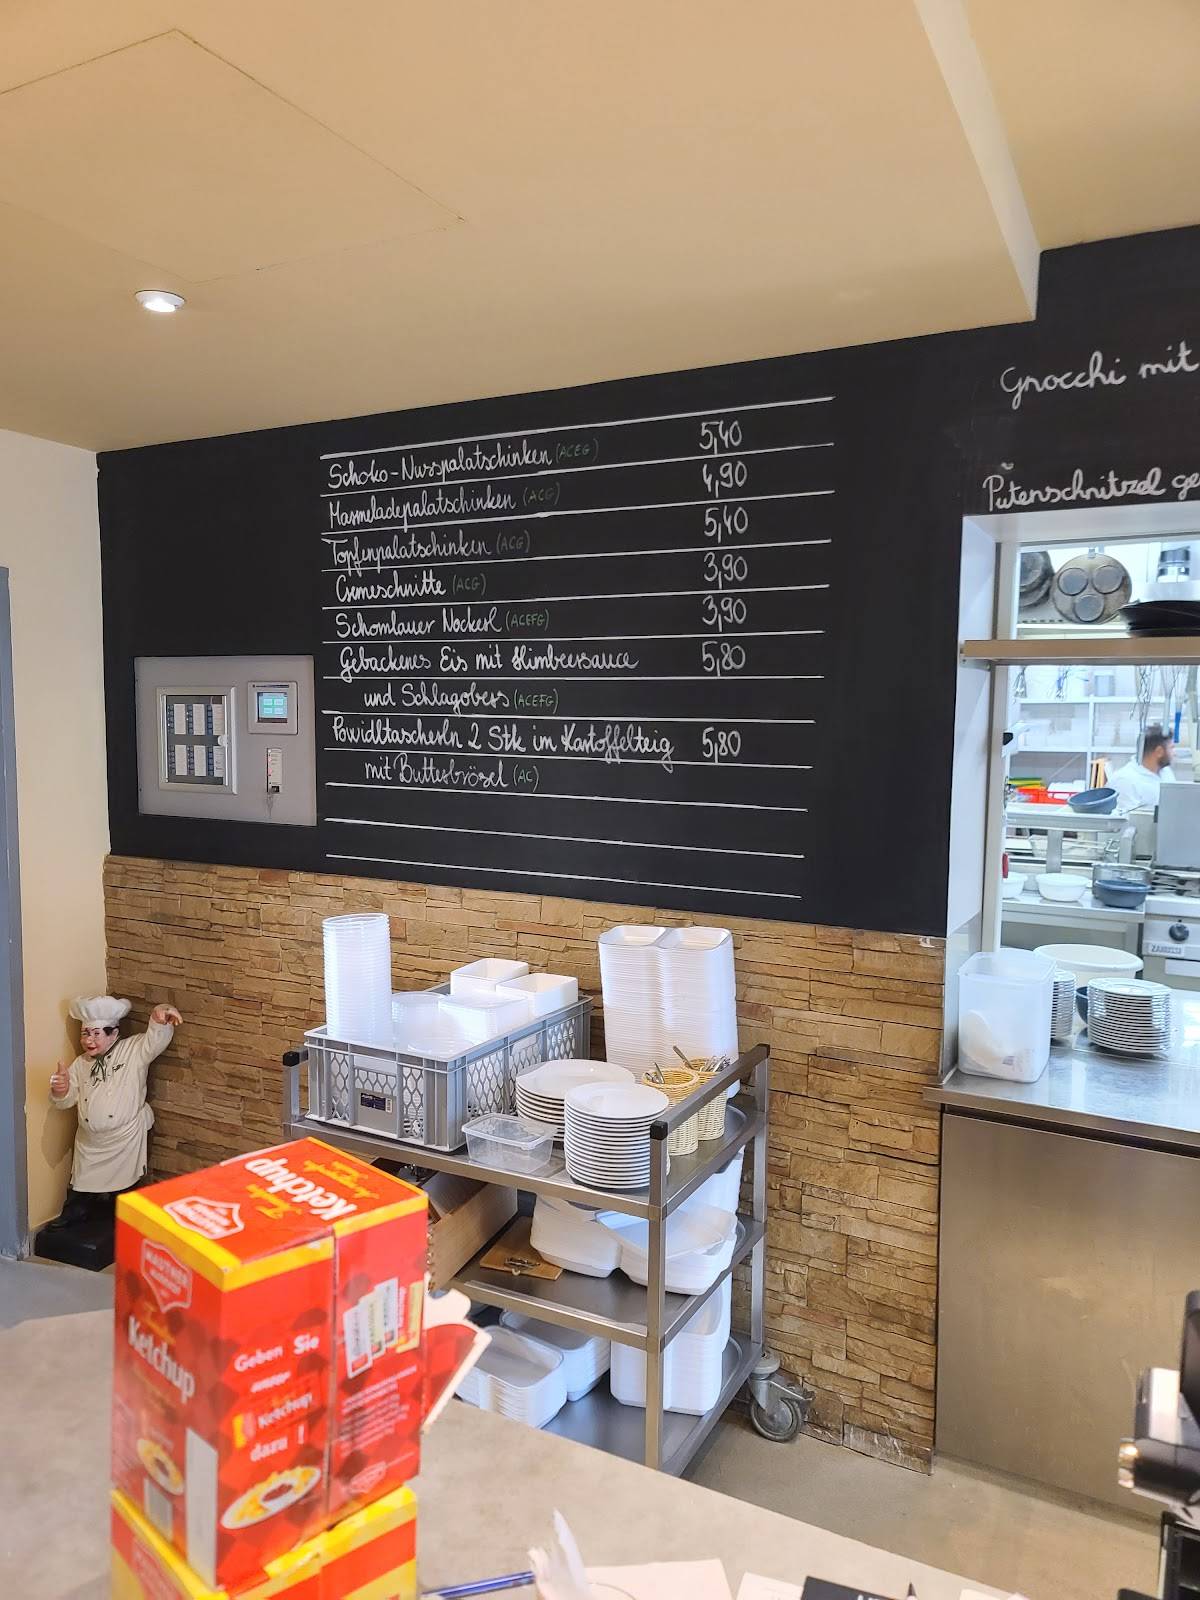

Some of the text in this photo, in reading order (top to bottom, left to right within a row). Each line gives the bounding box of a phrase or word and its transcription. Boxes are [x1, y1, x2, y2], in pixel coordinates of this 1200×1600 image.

[1000, 339, 1200, 410] Gnocchi mit
[700, 420, 742, 455] 5,40
[702, 461, 747, 498] 4,90
[321, 529, 491, 577] Topfenpalatschinken
[703, 505, 748, 543] 5,40
[703, 552, 747, 590] 3,90
[442, 606, 502, 635] Nockerl
[702, 595, 747, 633] 3,90
[339, 641, 745, 683] Gebackenes Eis mit Himbeersauce 5,80
[364, 684, 396, 707] und
[401, 682, 510, 717] Schlagobers
[467, 722, 483, 751] 2
[488, 724, 526, 752] Stk
[533, 726, 557, 754] im
[560, 722, 676, 774] Kartoffelteig
[702, 727, 742, 763] 5,80
[365, 756, 393, 781] mit
[513, 768, 541, 793] (AC)
[245, 1157, 358, 1222] Ketchup
[128, 1314, 196, 1404] Ketchup
[234, 1333, 320, 1373] Geben Sie
